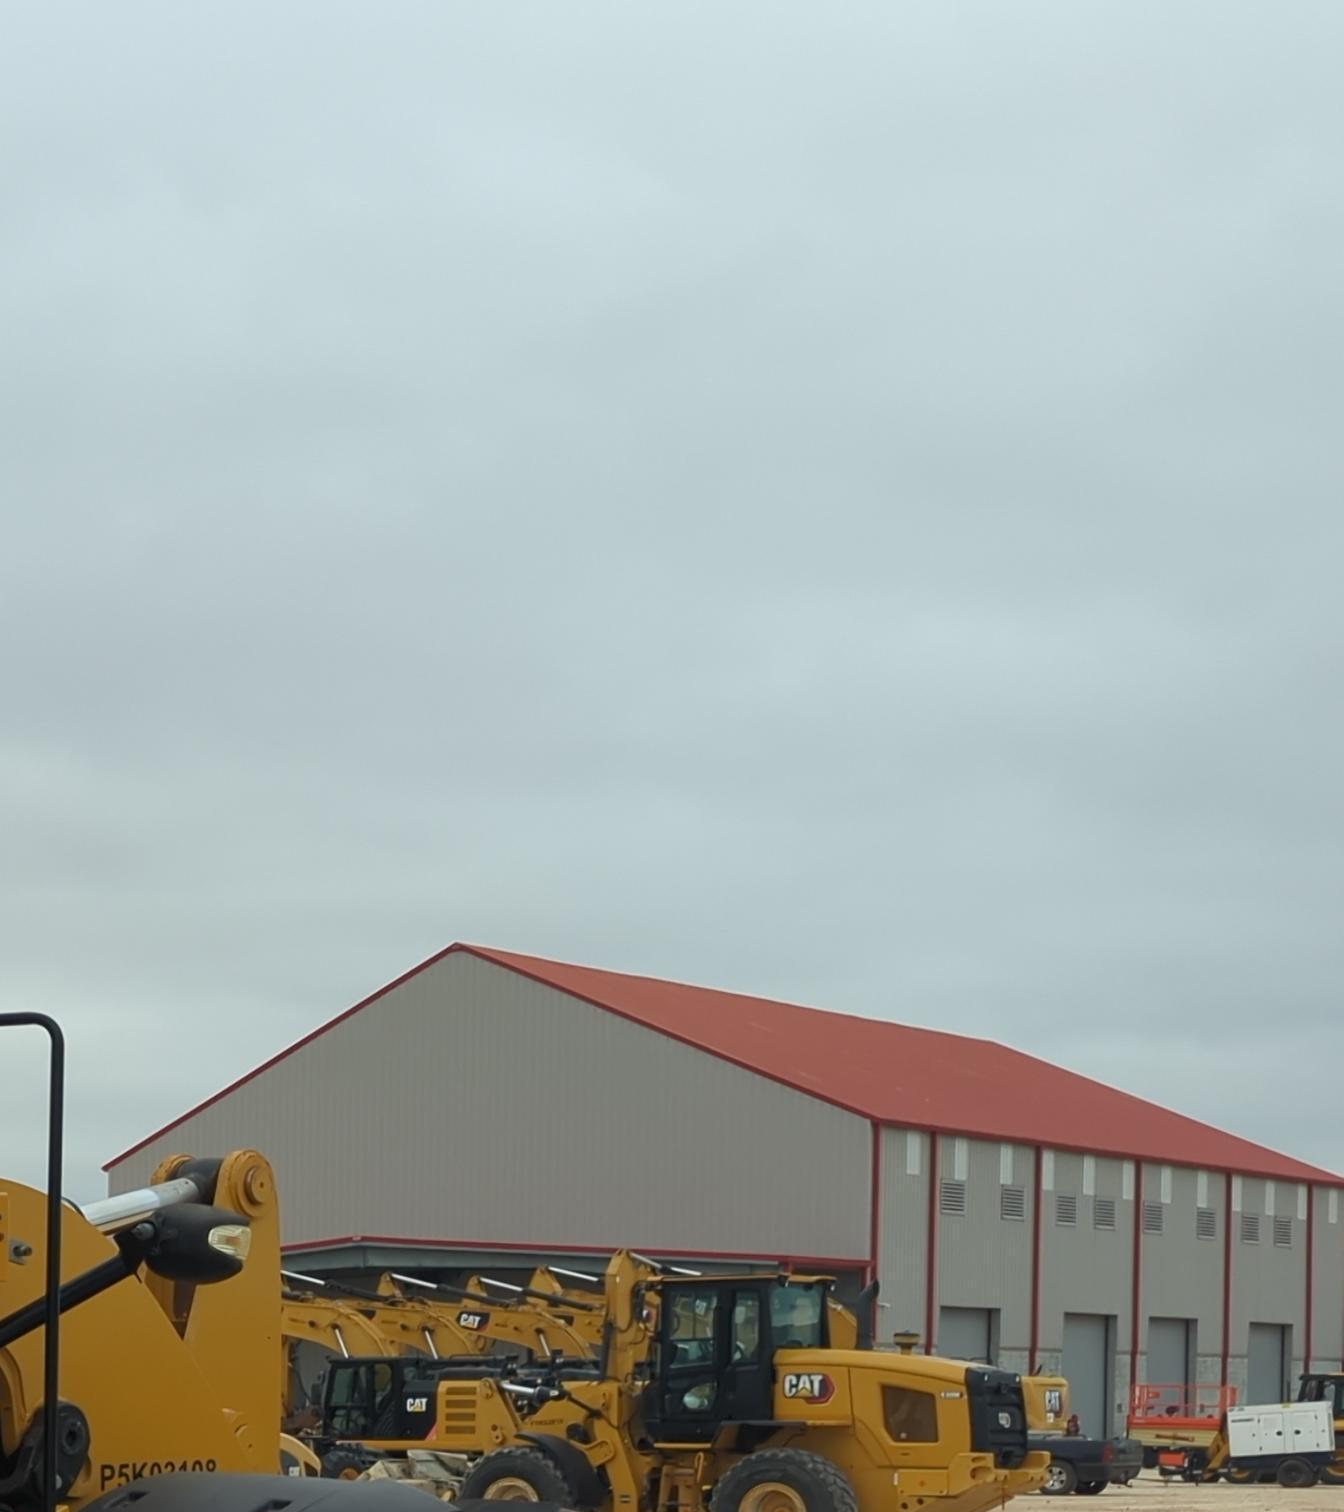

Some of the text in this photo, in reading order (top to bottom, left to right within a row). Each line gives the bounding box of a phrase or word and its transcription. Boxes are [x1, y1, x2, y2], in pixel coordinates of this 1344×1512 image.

[459, 1312, 482, 1329] CAT
[784, 1374, 824, 1398] CAT
[406, 1397, 428, 1413] CAT
